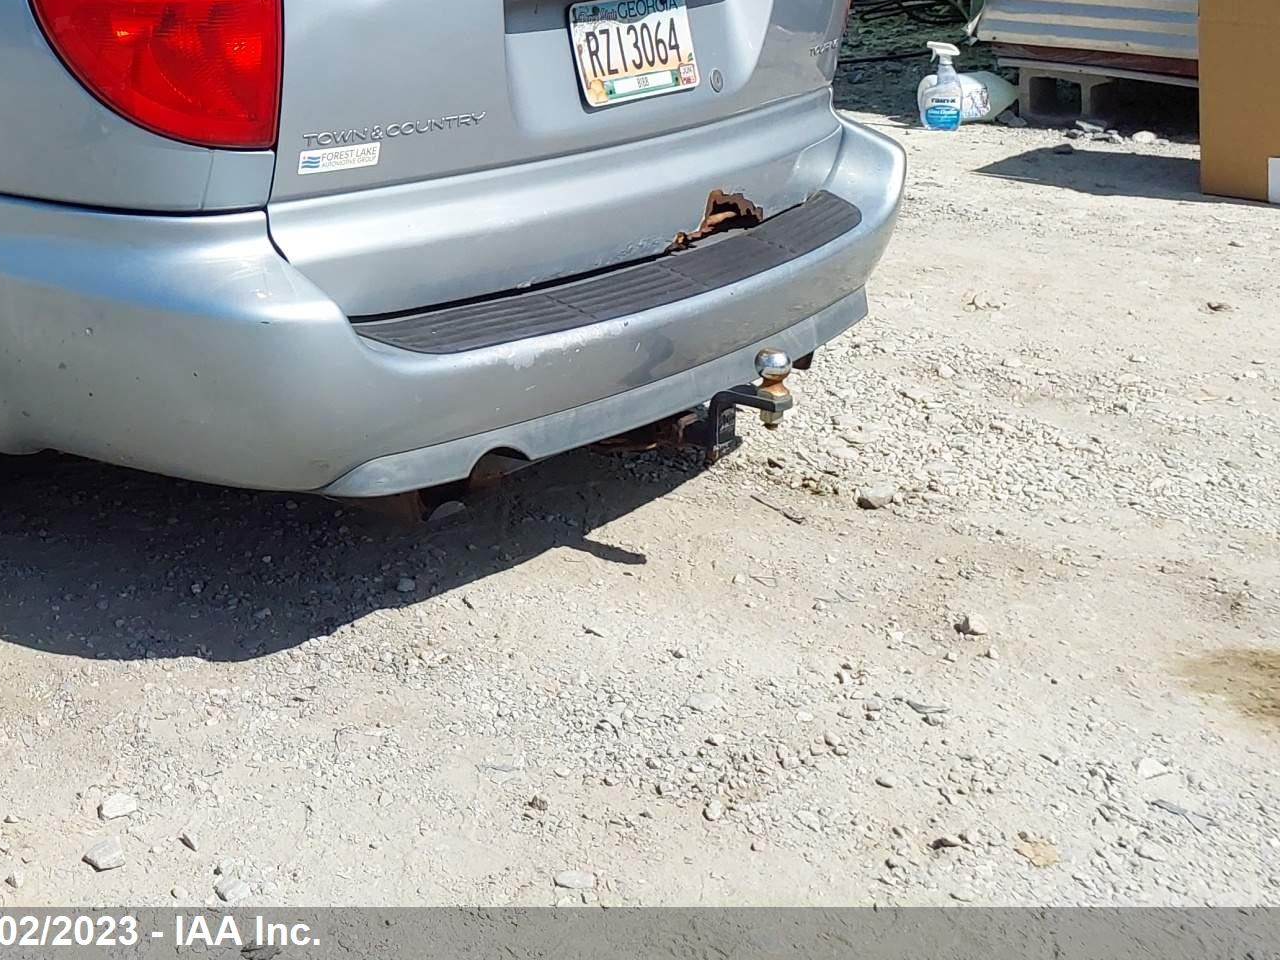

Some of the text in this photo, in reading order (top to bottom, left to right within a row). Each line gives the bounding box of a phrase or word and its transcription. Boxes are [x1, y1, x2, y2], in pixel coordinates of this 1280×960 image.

[303, 111, 487, 147] TOWN & COUNTRY
[321, 146, 378, 161] FOREST LAKE
[321, 154, 377, 168] AUTOMOTIVE GROUP
